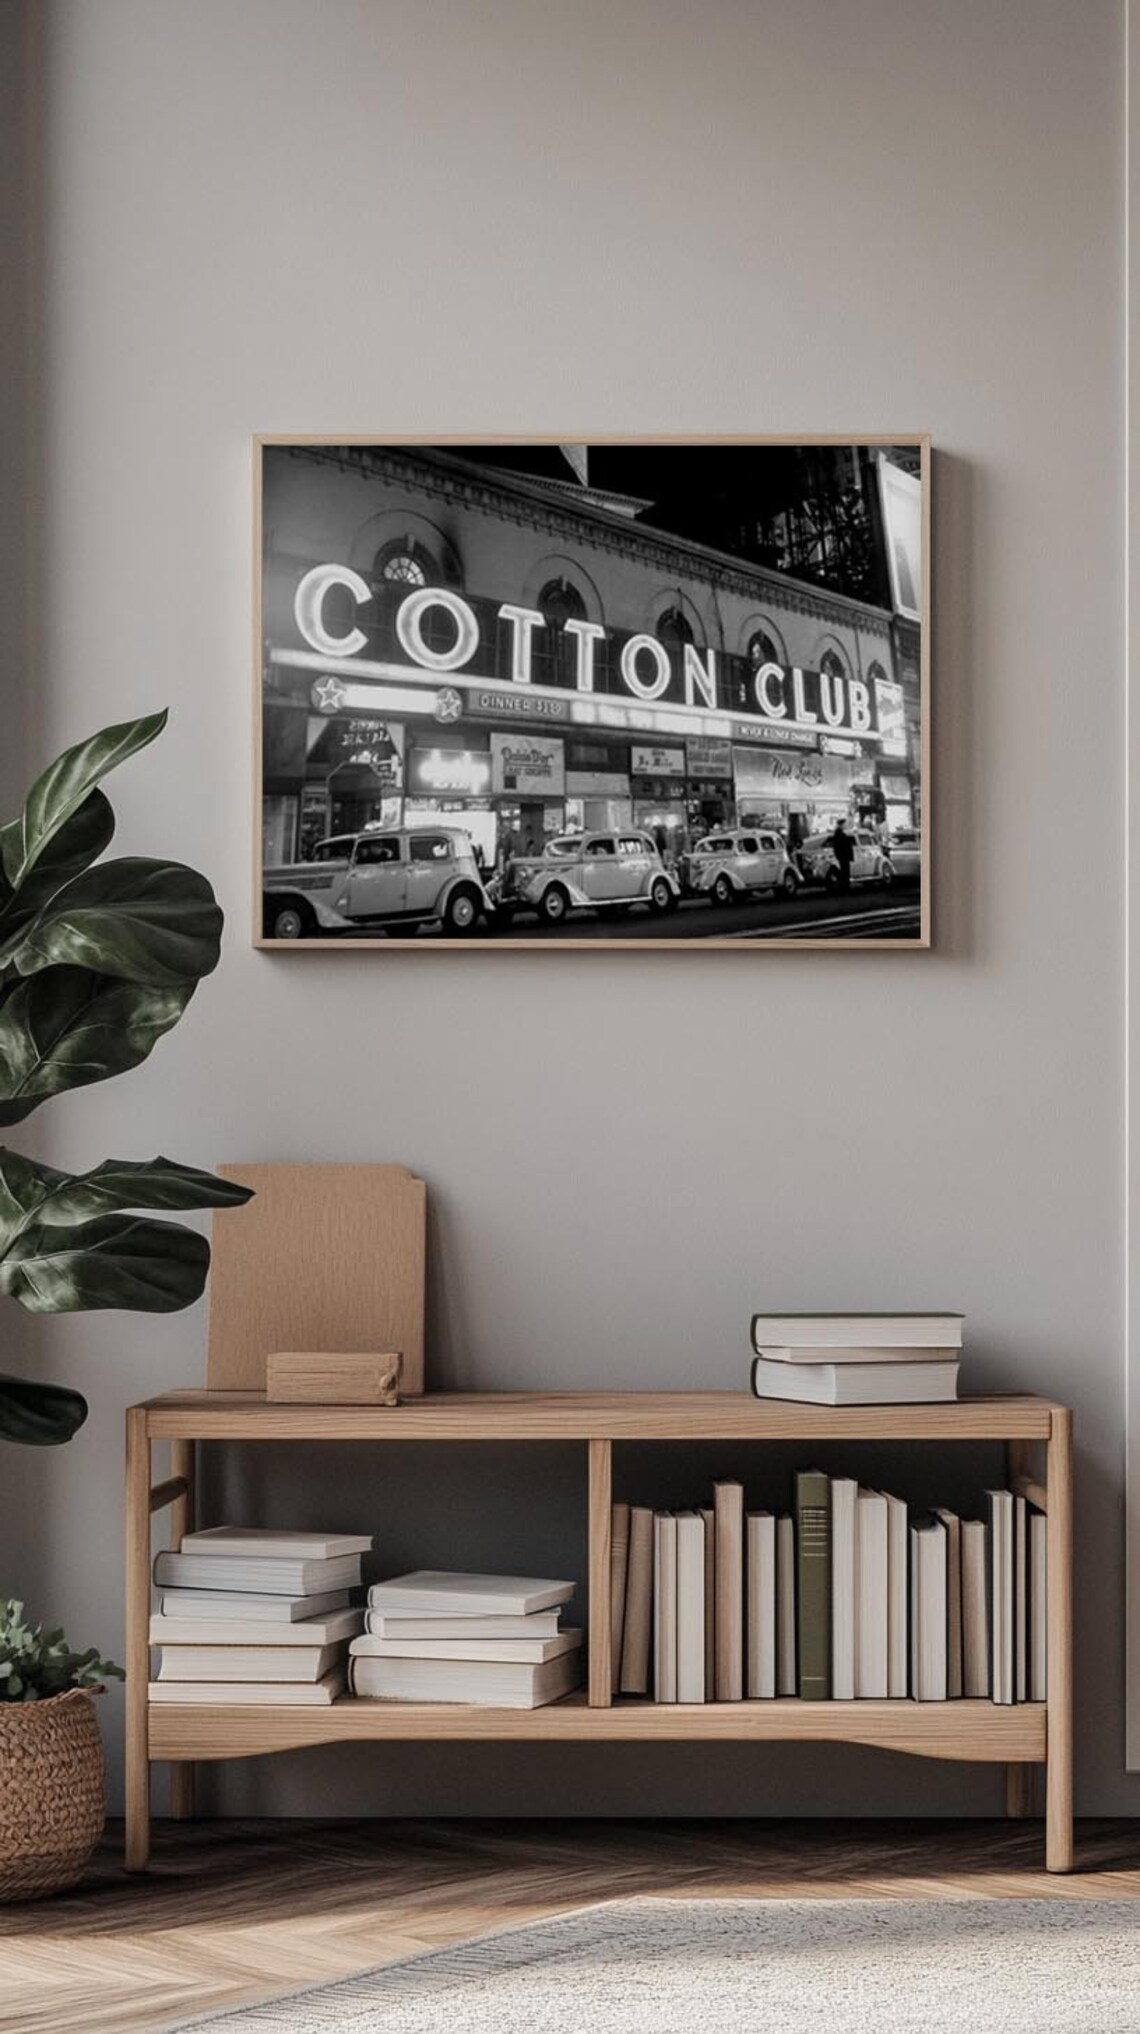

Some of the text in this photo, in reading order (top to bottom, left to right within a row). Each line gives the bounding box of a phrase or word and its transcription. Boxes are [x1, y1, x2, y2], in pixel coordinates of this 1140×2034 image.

[294, 563, 871, 731] COTTON CLUB
[481, 695, 530, 712] DINNER
